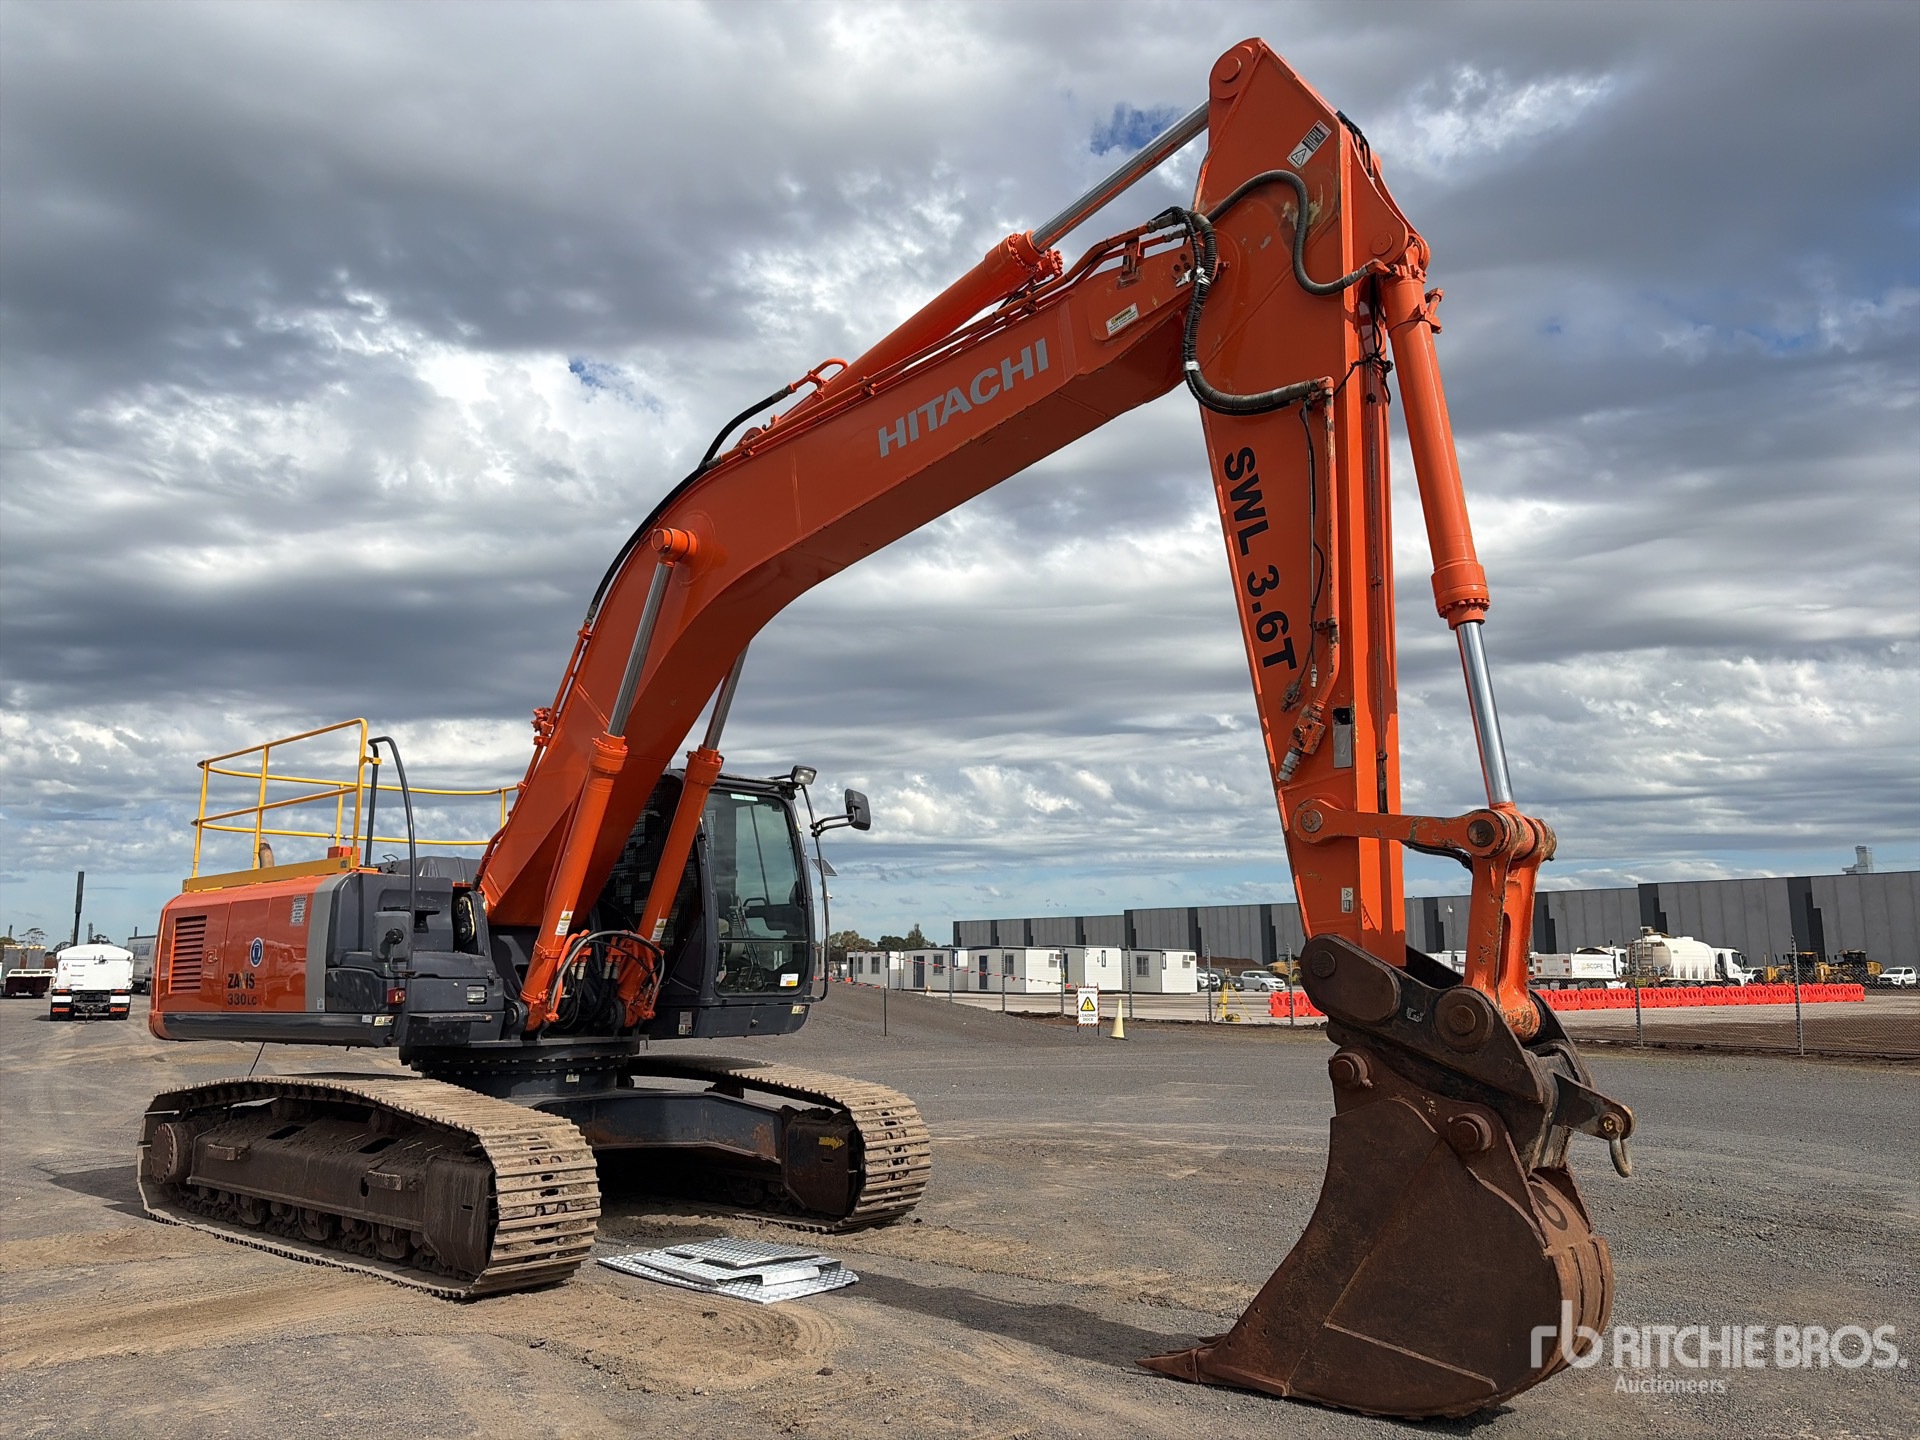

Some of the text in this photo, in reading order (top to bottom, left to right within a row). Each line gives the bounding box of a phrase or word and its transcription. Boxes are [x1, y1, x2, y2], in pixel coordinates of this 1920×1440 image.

[878, 338, 1048, 458] HITACHI
[1224, 446, 1297, 670] SWL 3.6T
